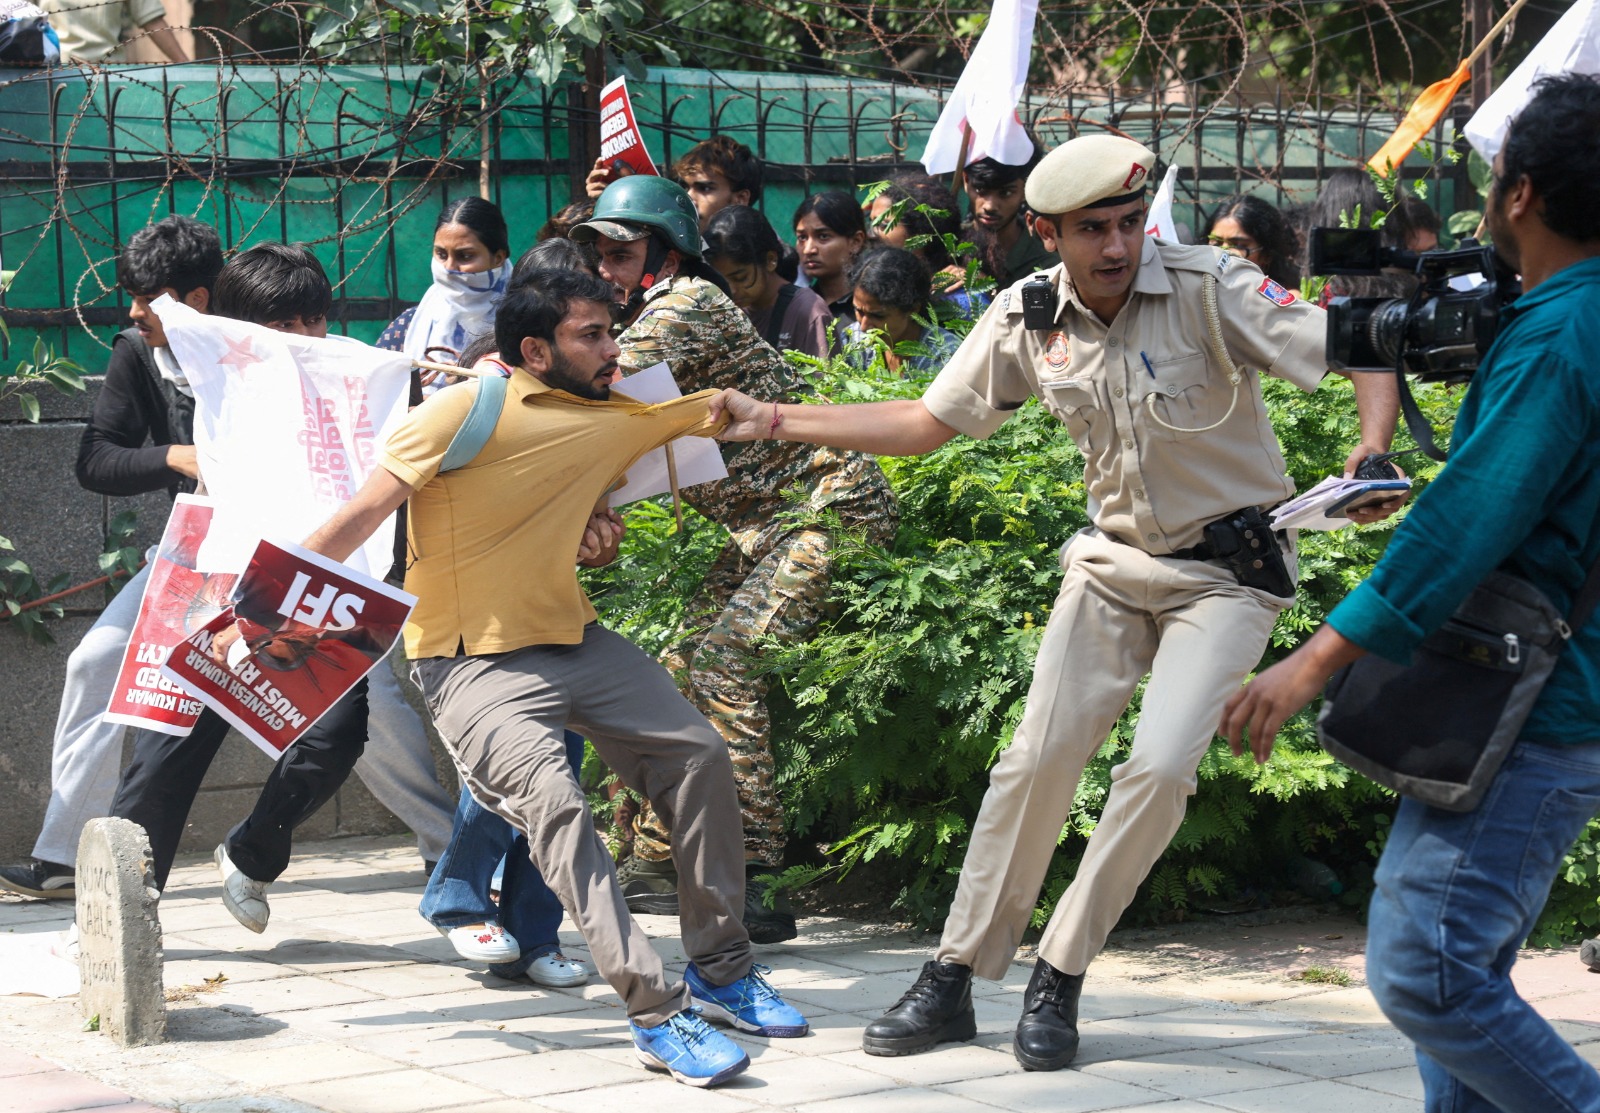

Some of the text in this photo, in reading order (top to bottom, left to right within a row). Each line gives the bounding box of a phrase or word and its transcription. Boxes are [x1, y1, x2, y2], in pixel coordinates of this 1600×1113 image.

[277, 570, 366, 632] SFI
[135, 642, 172, 665] CY!
[126, 688, 177, 711] KUMAR
[185, 649, 285, 731] GYANESH KUMAR
[253, 679, 307, 730] MUST
